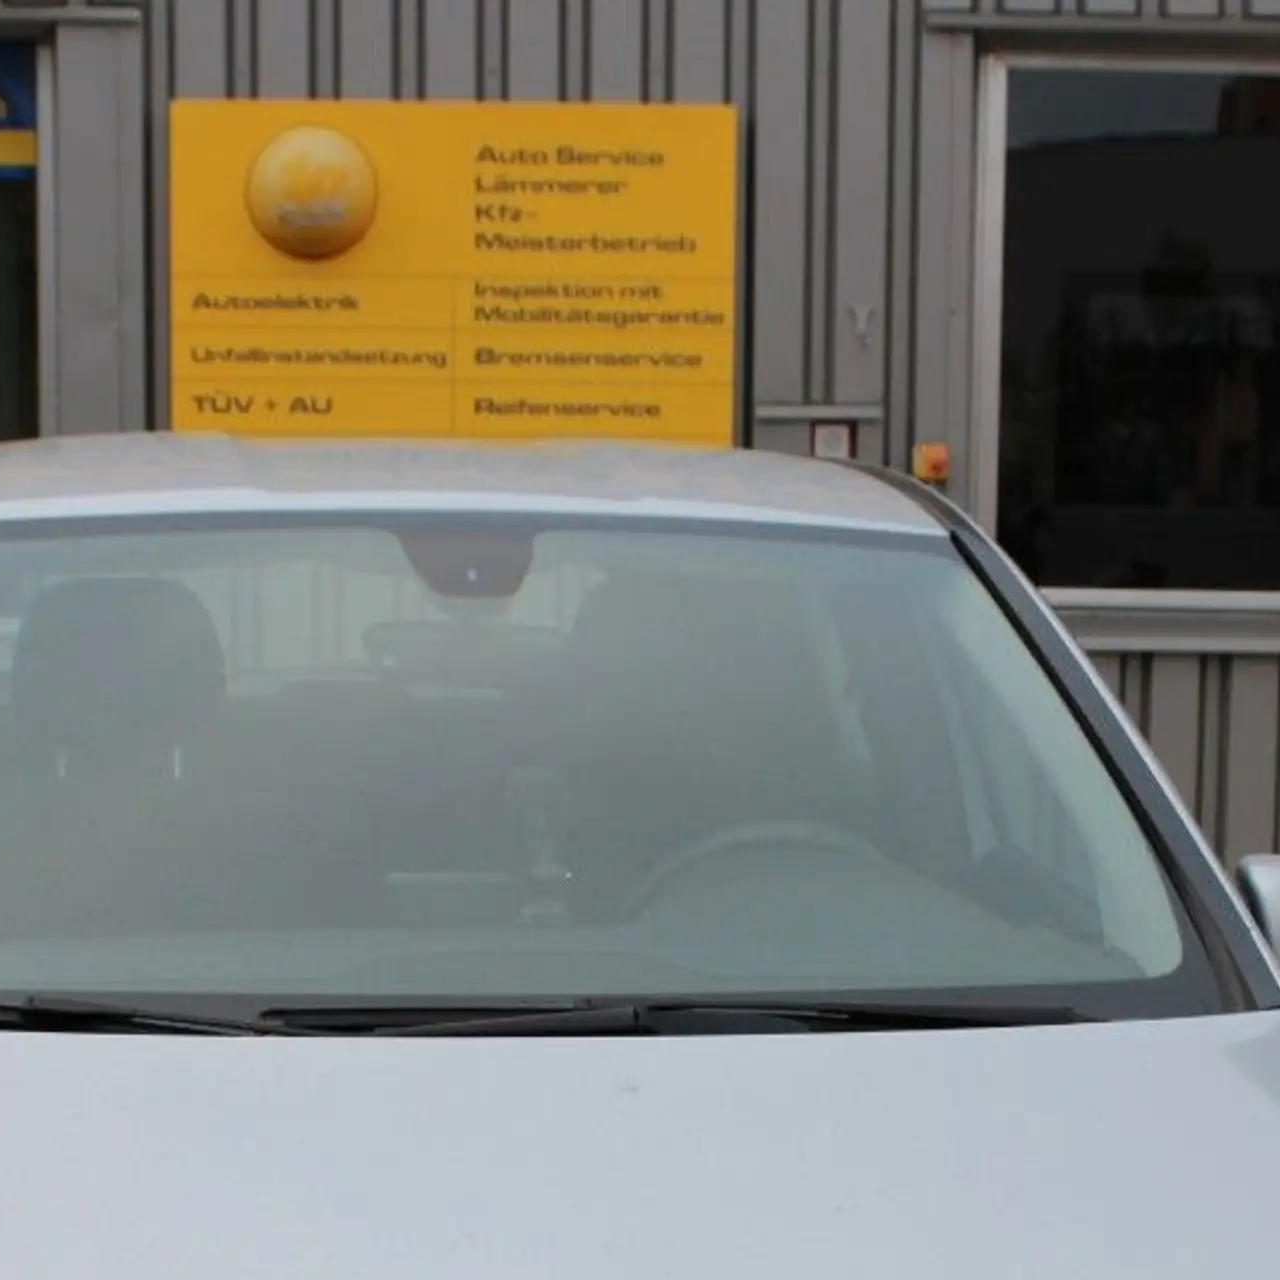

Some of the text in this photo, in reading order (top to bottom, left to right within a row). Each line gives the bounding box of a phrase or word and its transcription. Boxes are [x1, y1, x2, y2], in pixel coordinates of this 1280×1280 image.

[476, 145, 666, 167] Auto Service
[474, 232, 697, 253] Meisterbetrieb
[191, 292, 361, 311] Autoelektrik
[474, 282, 663, 301] Inspektion mit
[474, 305, 725, 329] Mobilitätsgarantie
[191, 347, 448, 370] Unfallinstandsetzung
[475, 347, 703, 367] Bremsenservice
[192, 391, 254, 415] TÜV
[288, 396, 334, 414] AU
[474, 398, 661, 417] Reifenservice
